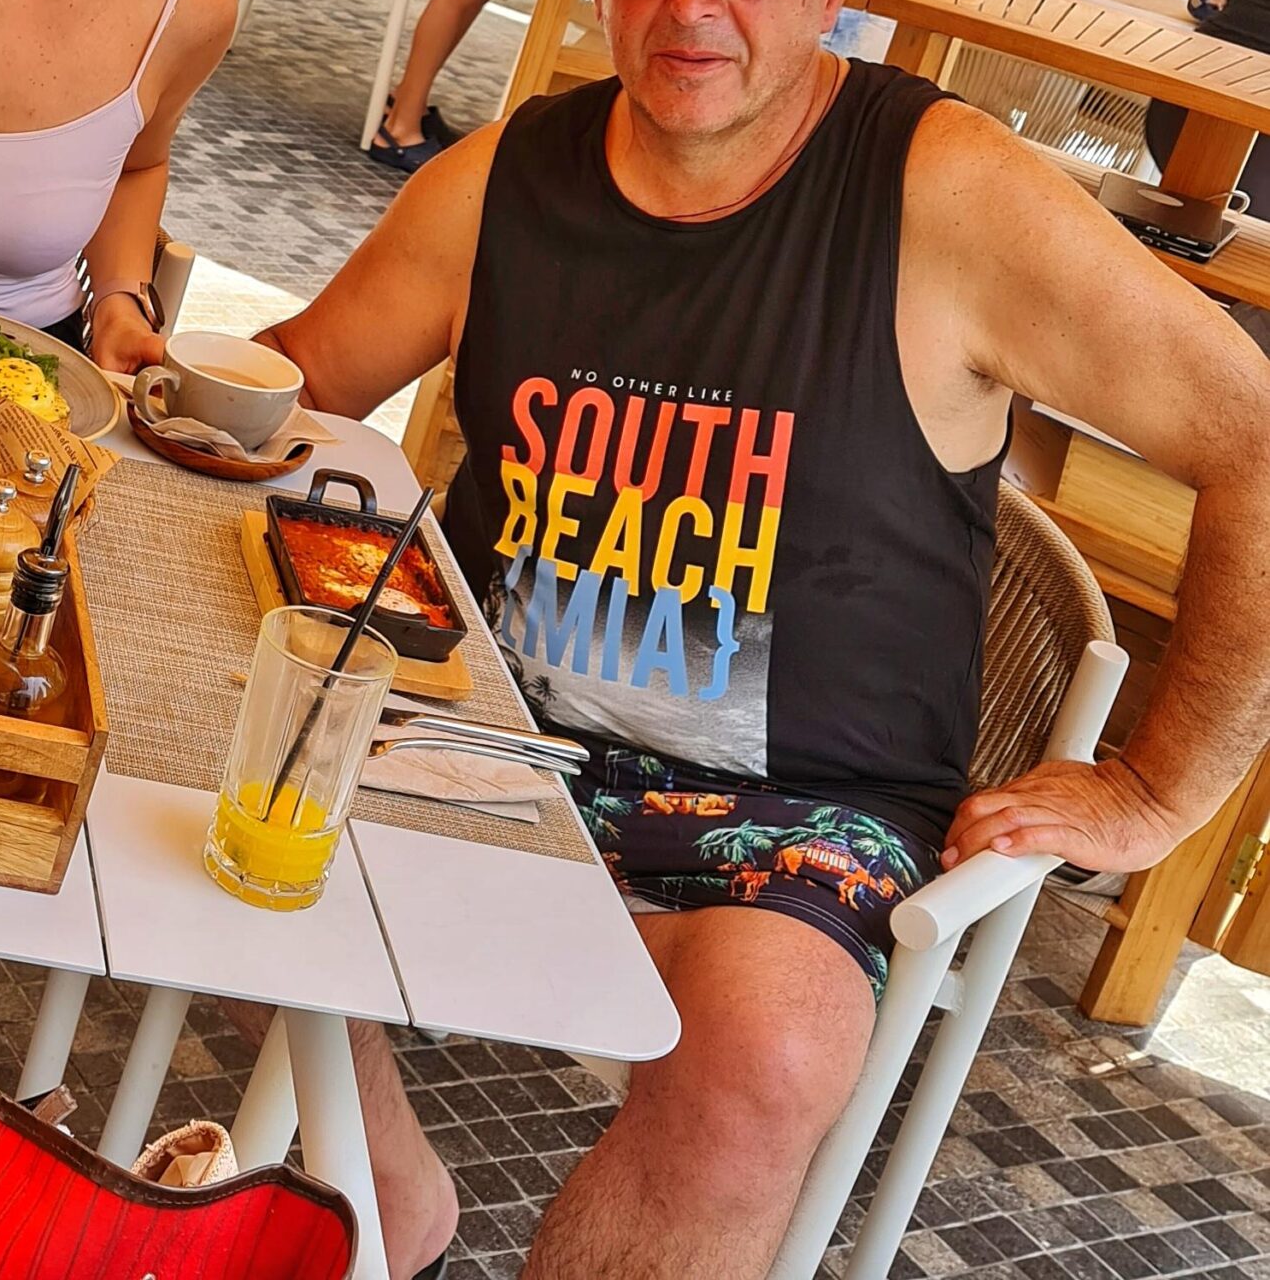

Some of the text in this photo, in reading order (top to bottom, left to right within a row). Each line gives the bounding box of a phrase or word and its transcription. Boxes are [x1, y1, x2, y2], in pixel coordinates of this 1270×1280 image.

[501, 376, 795, 509] SOUTH
[570, 368, 734, 402] NO OTHER LIKE
[494, 459, 782, 614] BEACH
